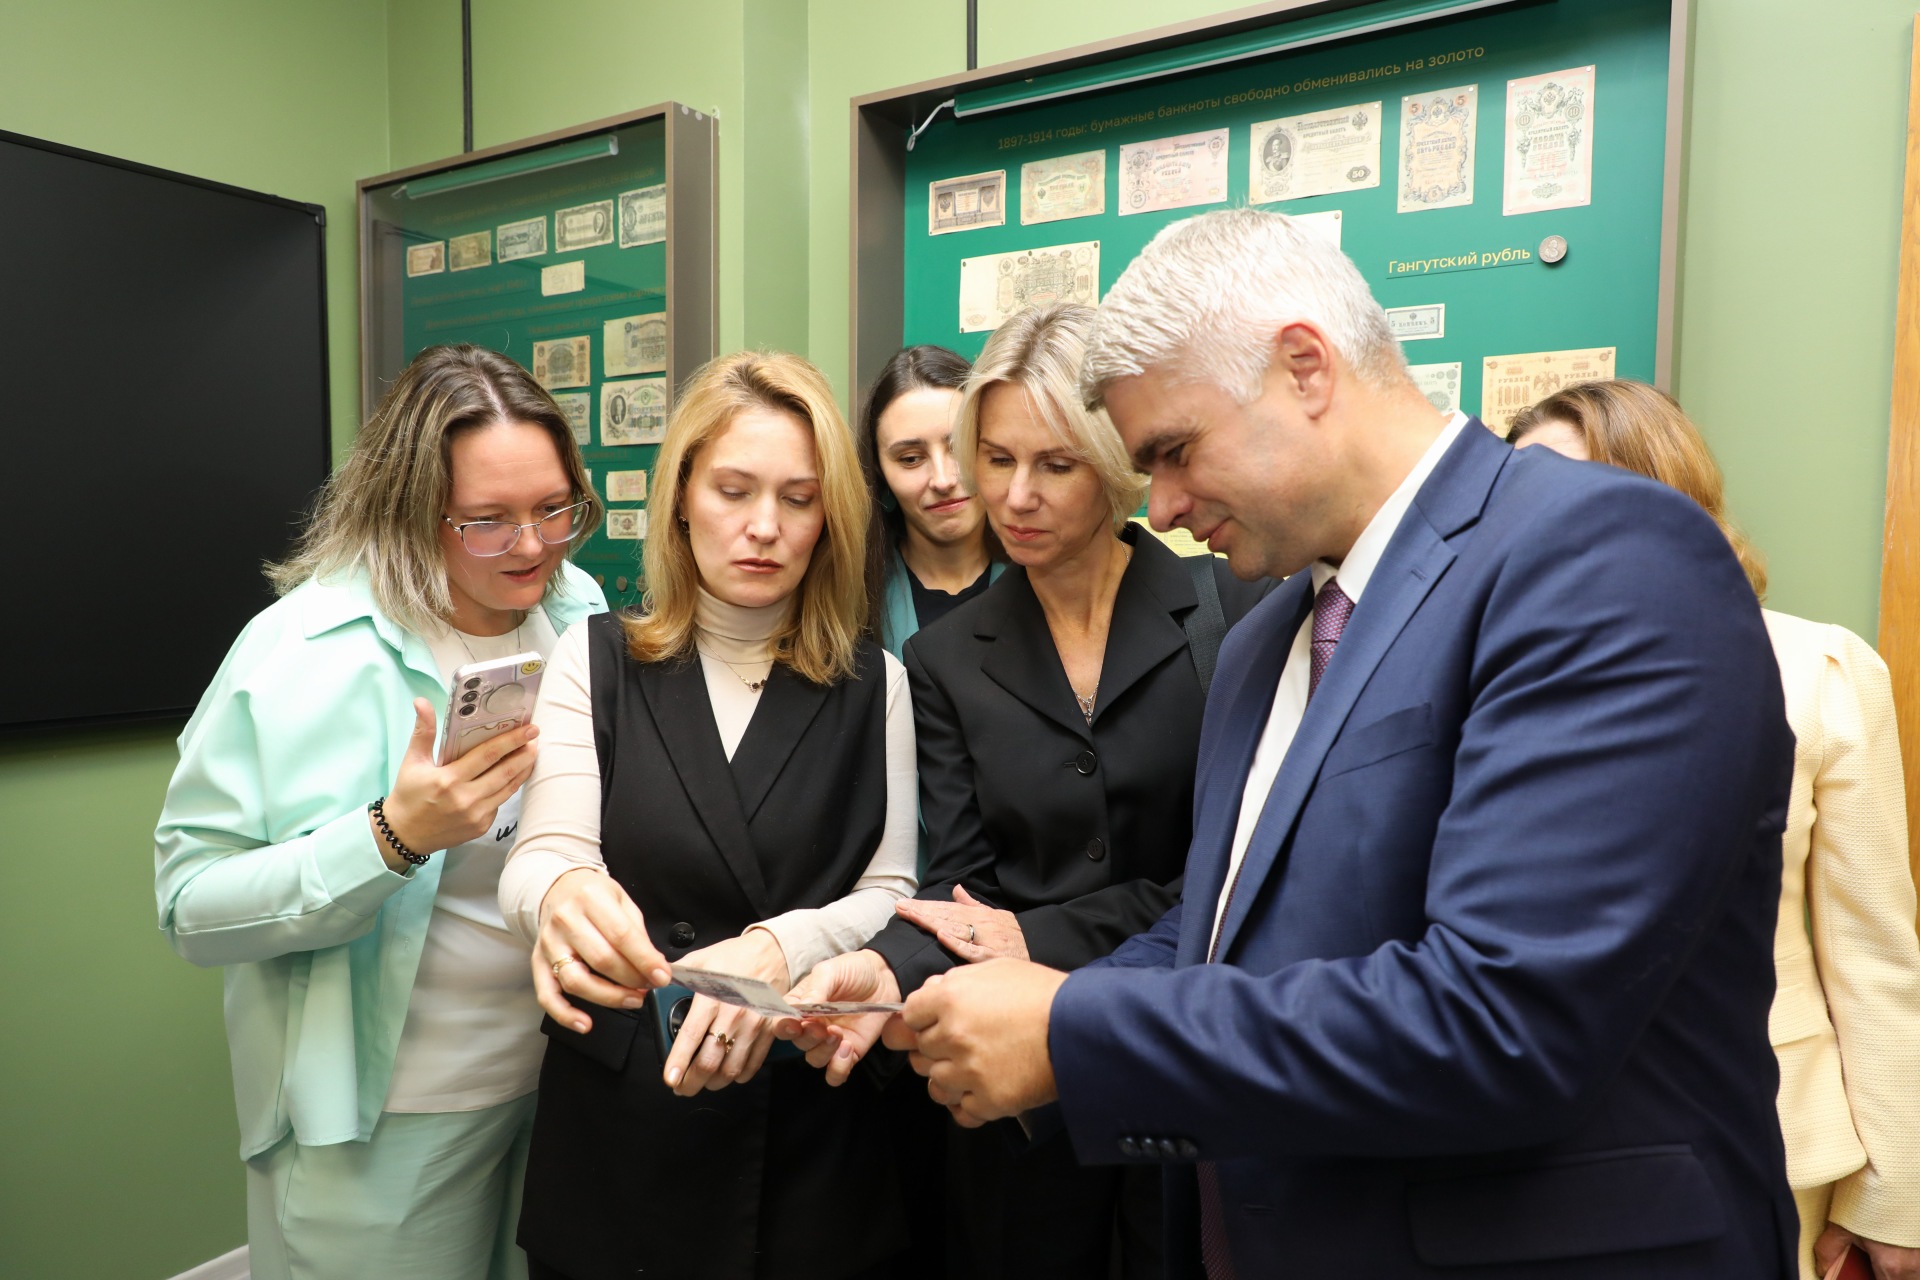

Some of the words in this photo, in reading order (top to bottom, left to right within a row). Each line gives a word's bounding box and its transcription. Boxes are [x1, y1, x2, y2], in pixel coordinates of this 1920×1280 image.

[998, 129, 1053, 150] 1897-1914
[1055, 124, 1088, 138] годы:
[1090, 110, 1155, 132] бумажные
[1158, 97, 1221, 118] банкноты
[1224, 84, 1290, 105] свободно
[1293, 66, 1401, 93] обменивались
[1405, 59, 1424, 72] на
[1428, 46, 1485, 68] золото
[1457, 95, 1466, 106] 5
[1410, 103, 1419, 114] 5
[1351, 169, 1365, 179] 50
[1133, 194, 1143, 203] 25
[1388, 251, 1477, 274] Гангутский
[1481, 247, 1531, 267] рубль
